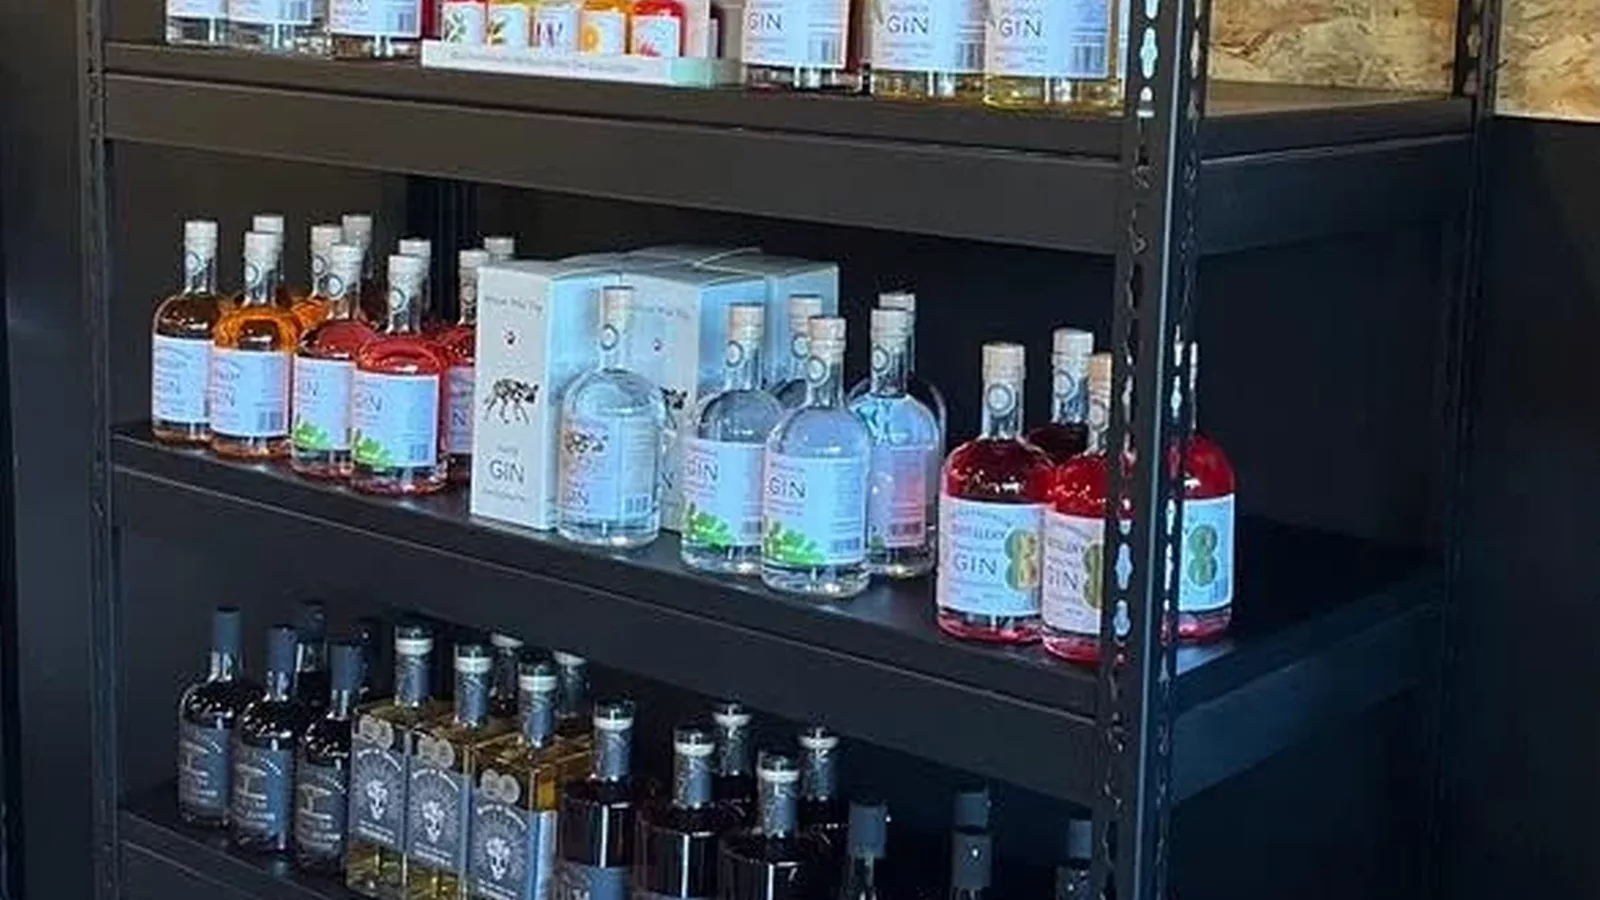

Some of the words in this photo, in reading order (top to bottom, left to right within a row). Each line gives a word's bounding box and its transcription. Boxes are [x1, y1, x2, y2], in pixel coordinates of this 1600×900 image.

[747, 11, 782, 31] GIN
[886, 14, 929, 35] GIN
[999, 17, 1042, 38] GIN
[488, 458, 525, 485] GIN
[769, 475, 806, 499] GIN
[953, 552, 998, 576] GIN
